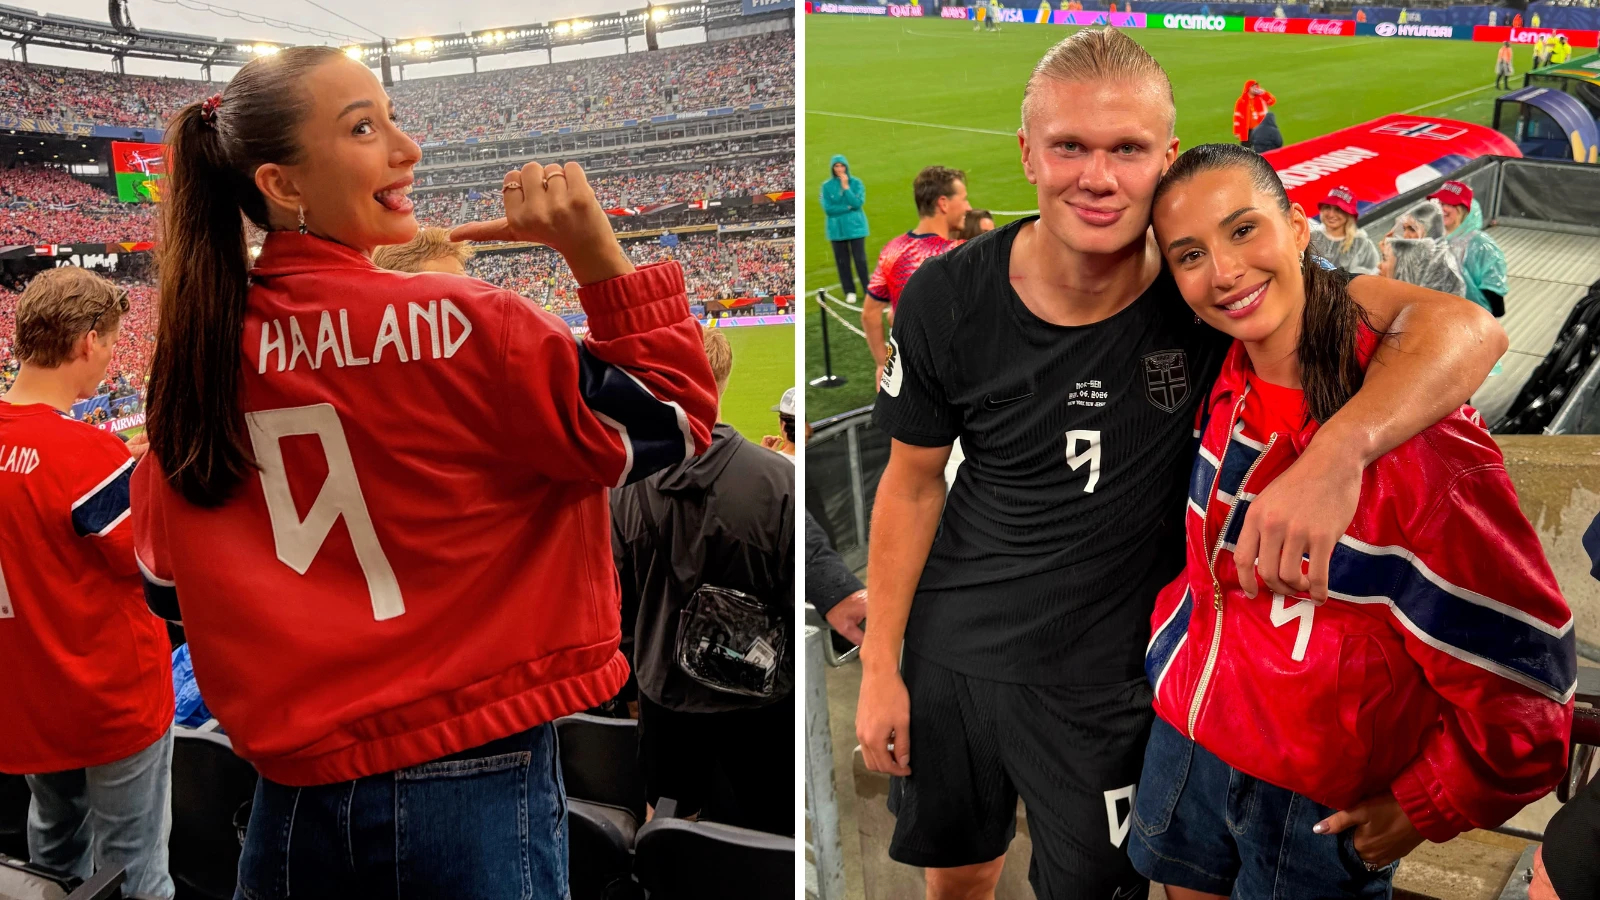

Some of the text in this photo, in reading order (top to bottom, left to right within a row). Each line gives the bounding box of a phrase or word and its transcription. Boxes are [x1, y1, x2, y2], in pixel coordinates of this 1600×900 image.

[998, 8, 1024, 22] VISA
[1163, 13, 1226, 30] aramco
[1398, 24, 1453, 37] HYUNDAI
[258, 299, 472, 374] HAALAND
[1065, 429, 1101, 493] 9
[245, 403, 406, 621] 9
